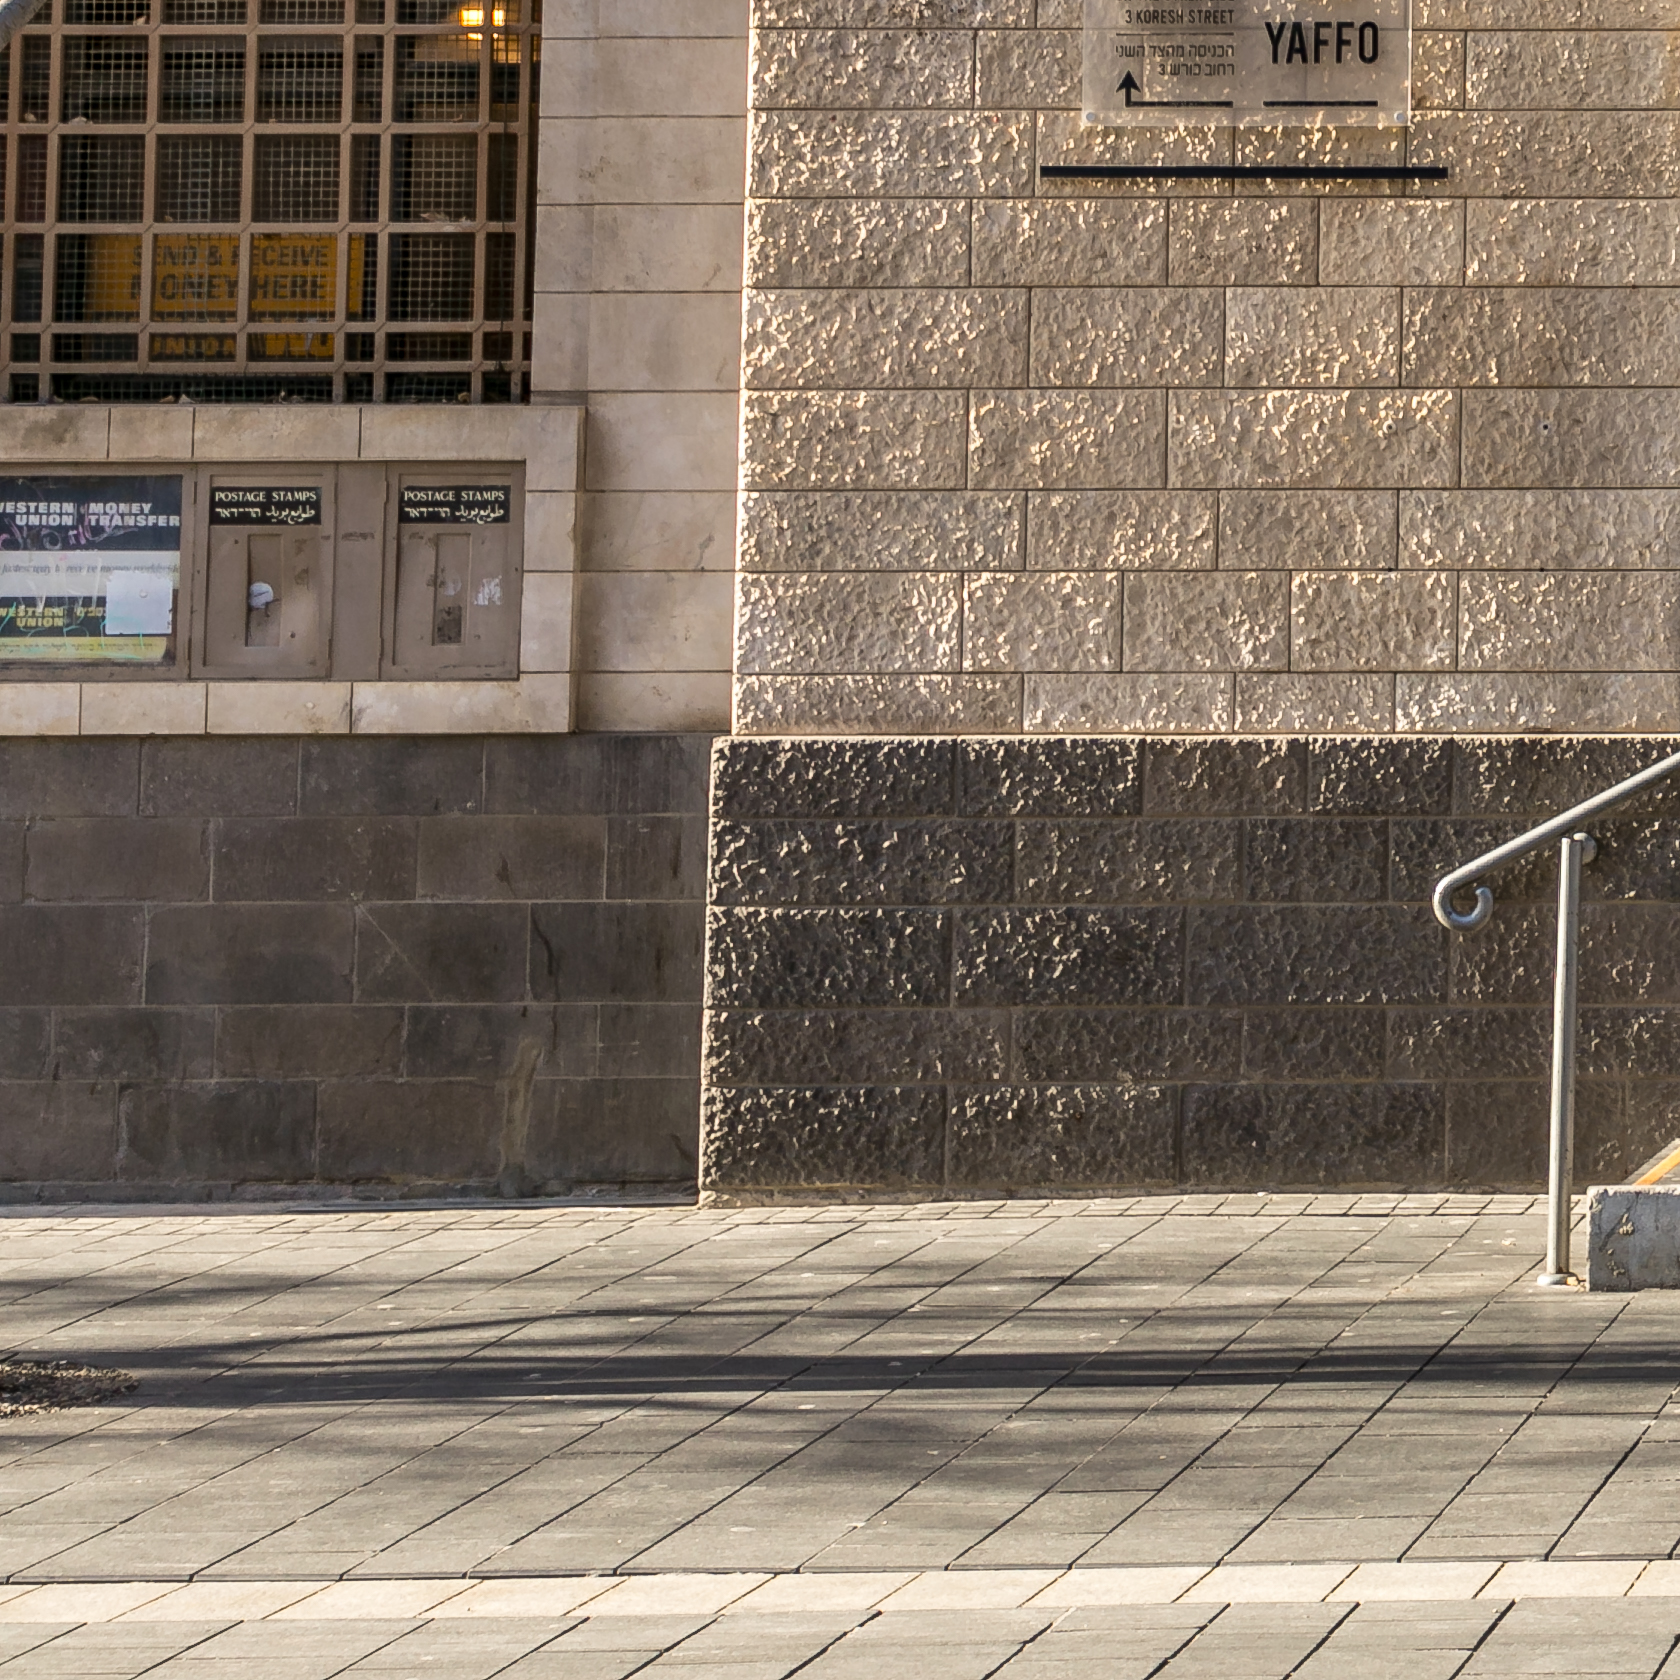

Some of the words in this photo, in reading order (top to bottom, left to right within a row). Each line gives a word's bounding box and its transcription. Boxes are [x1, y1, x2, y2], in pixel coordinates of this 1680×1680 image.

[1125, 9, 1132, 24] 3
[1136, 9, 1184, 24] KORESH
[1188, 9, 1235, 24] STREET
[1264, 21, 1379, 65] YAFFO
[1115, 44, 1146, 58] השני
[1148, 44, 1185, 58] מהצד
[1188, 44, 1235, 58] הכניסה
[1158, 63, 1166, 77] 3
[1169, 63, 1201, 77] כורש
[1204, 63, 1235, 77] רחוב
[250, 274, 327, 300] HERE
[215, 491, 267, 502] POSTAGE
[272, 491, 317, 502] STAMPS
[404, 491, 456, 502] POSTAGE
[461, 491, 505, 502] STAMPS
[88, 502, 153, 514] MONEY
[15, 514, 74, 526] UNION
[88, 515, 181, 527] TRANSFER
[16, 617, 64, 627] UNION
